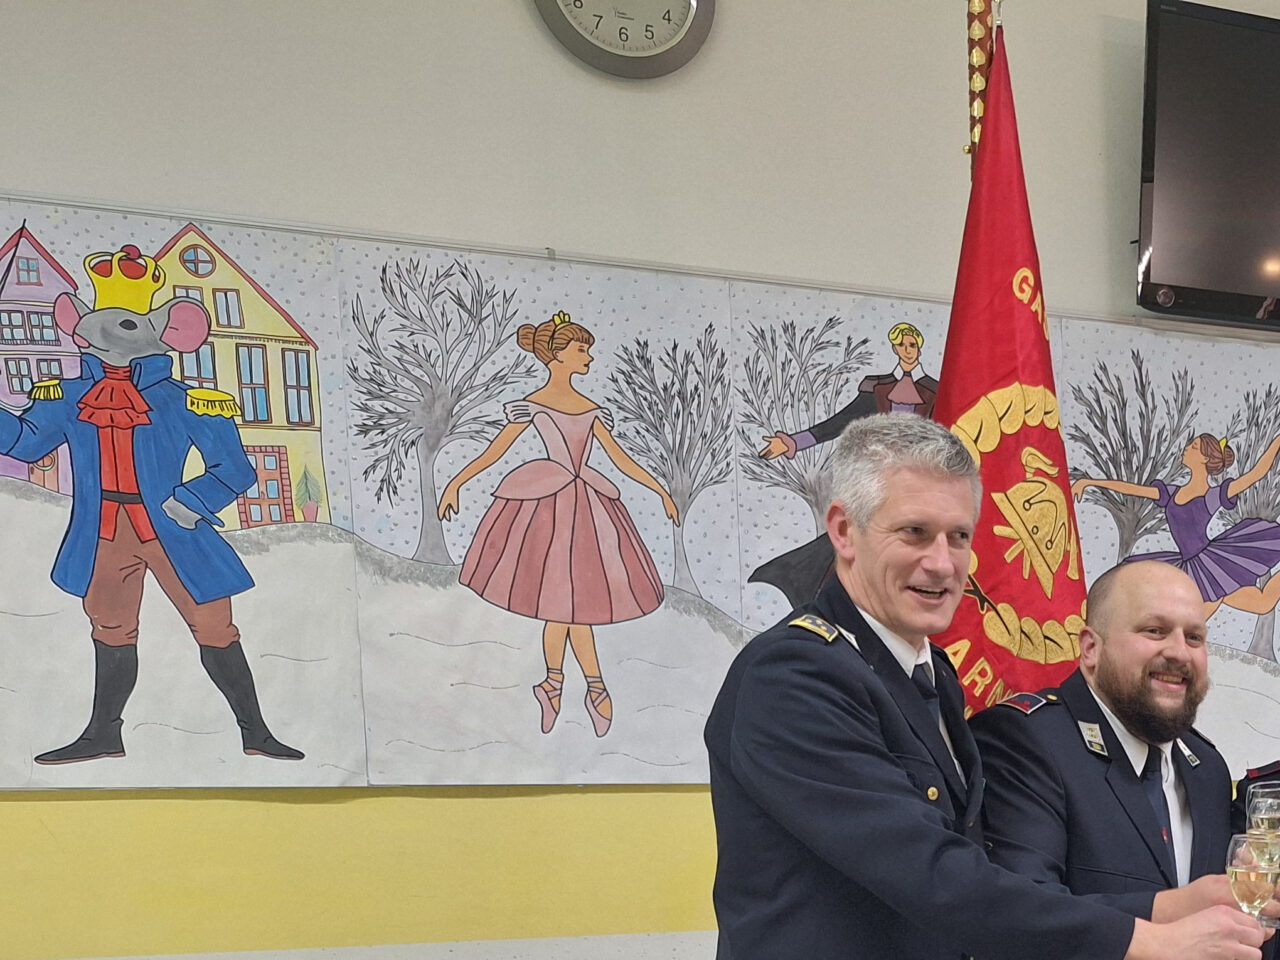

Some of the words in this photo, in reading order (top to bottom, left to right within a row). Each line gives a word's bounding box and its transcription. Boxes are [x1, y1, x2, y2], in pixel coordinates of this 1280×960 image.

[592, 14, 604, 30] 7
[662, 9, 673, 25] 4
[618, 26, 629, 42] 6
[644, 24, 655, 40] 5
